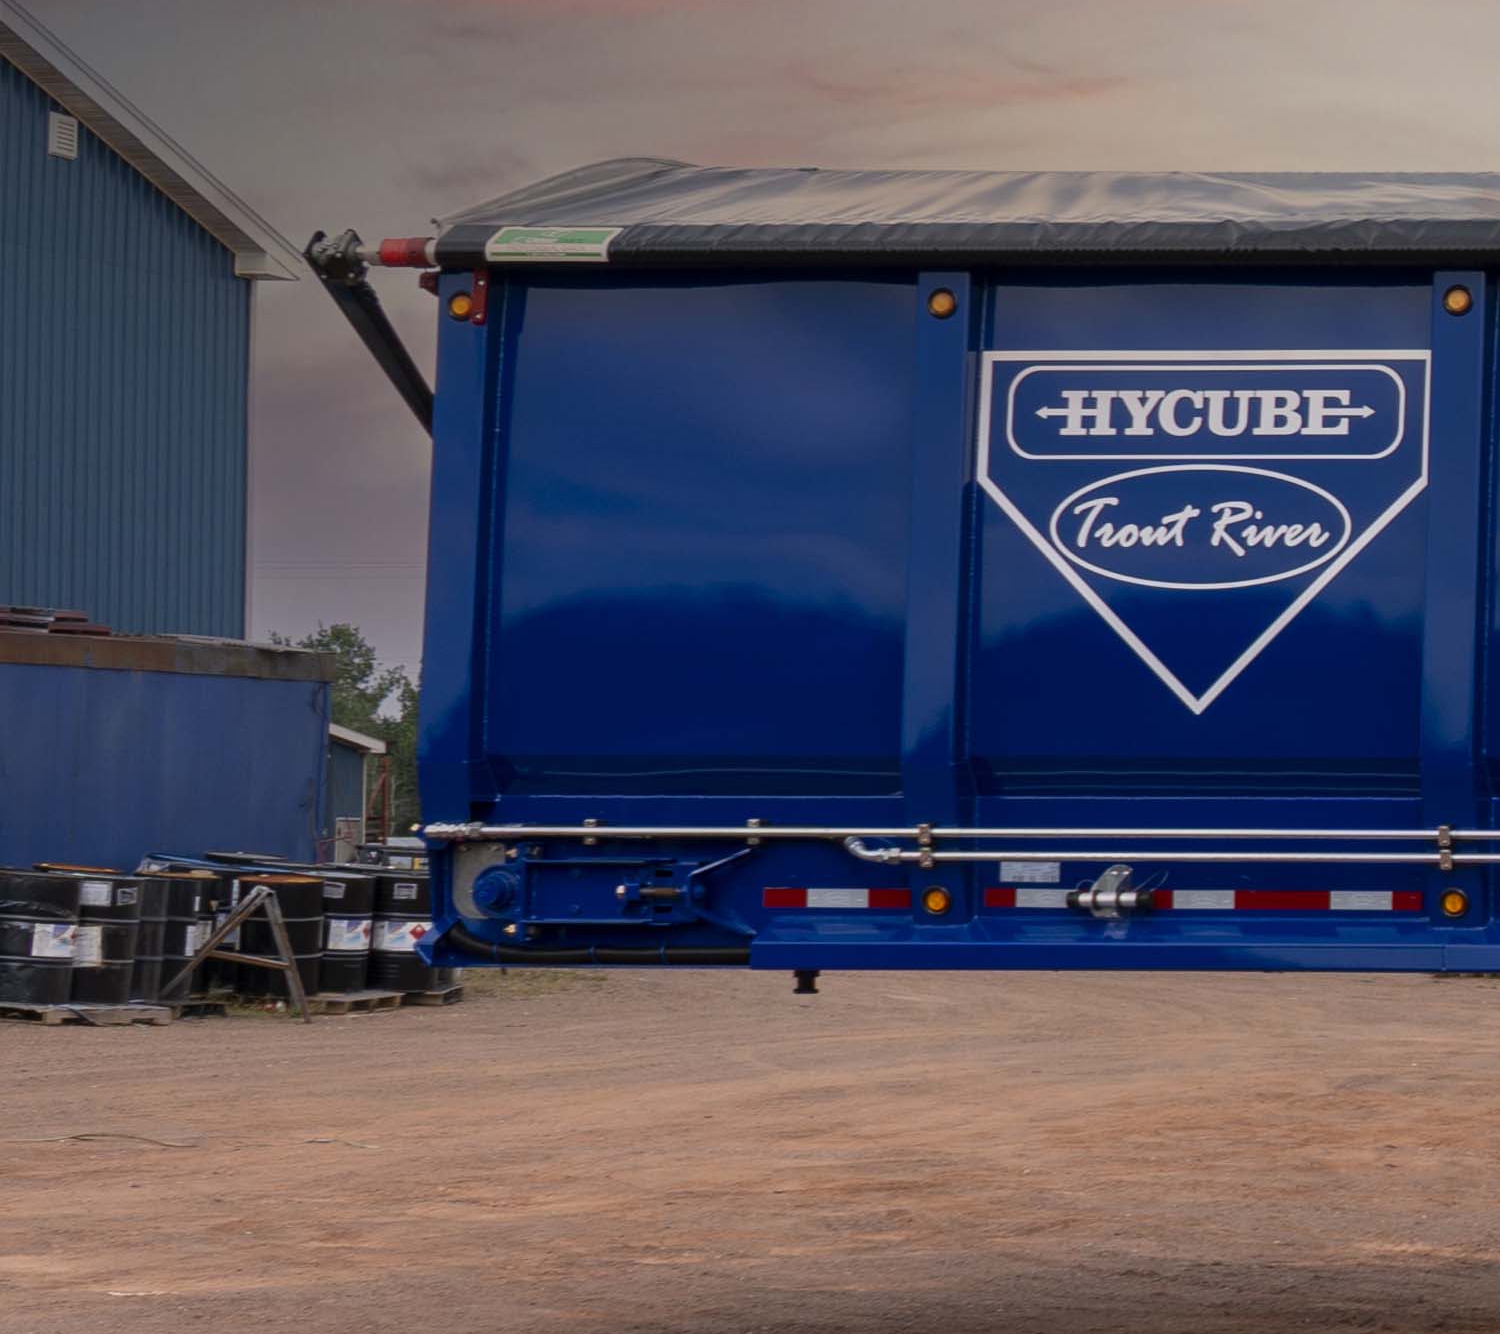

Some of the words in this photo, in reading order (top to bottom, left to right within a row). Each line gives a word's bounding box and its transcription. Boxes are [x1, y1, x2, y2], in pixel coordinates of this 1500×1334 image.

[1059, 389, 1351, 436] HYCUBE
[1073, 497, 1200, 547] Trout
[1210, 501, 1330, 557] River
